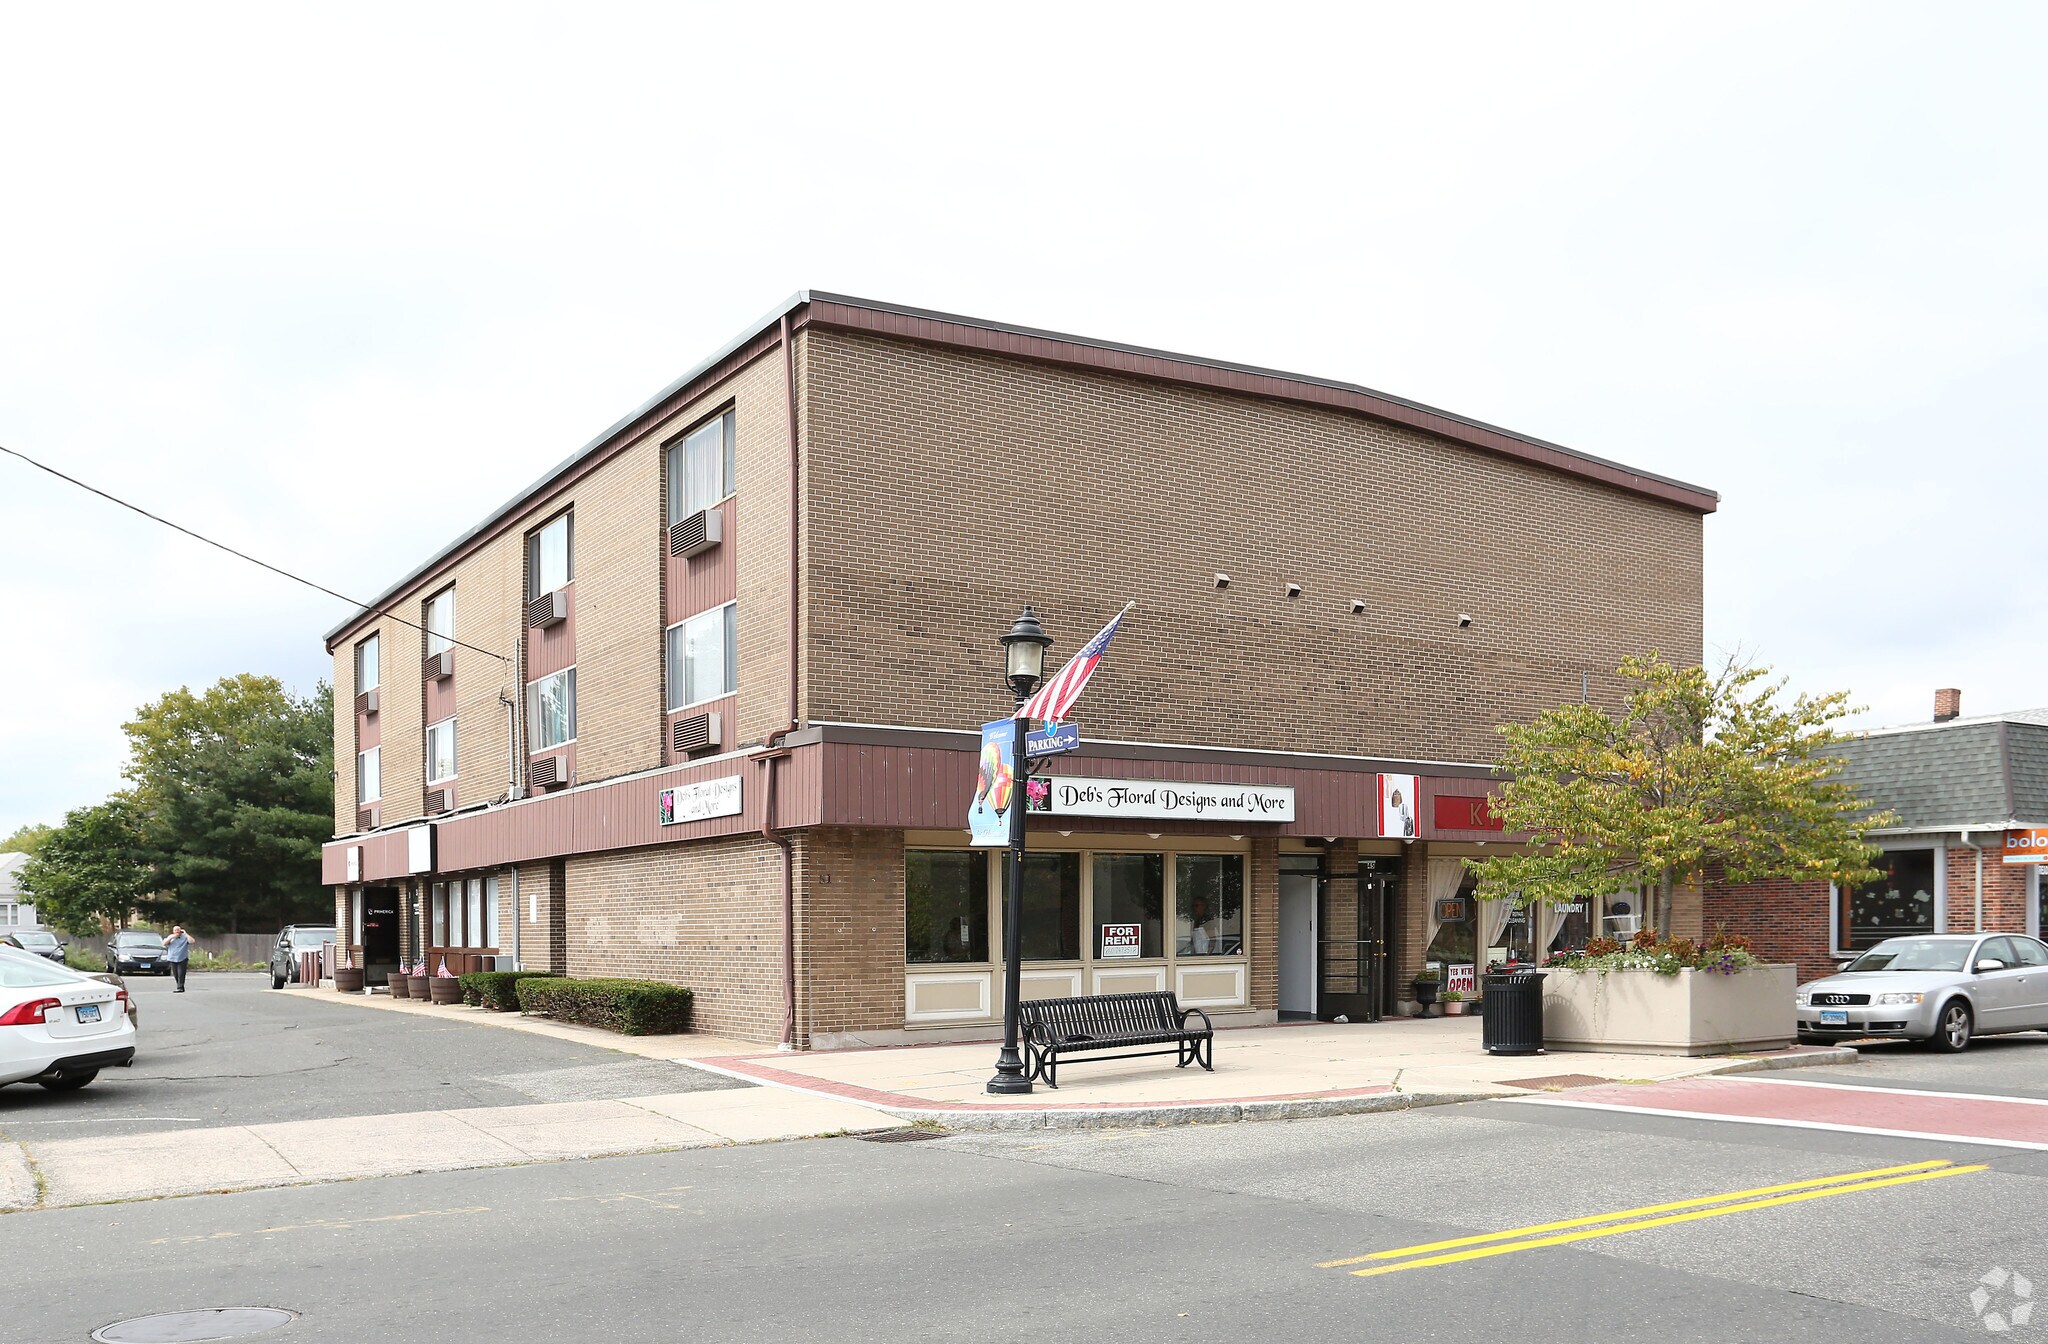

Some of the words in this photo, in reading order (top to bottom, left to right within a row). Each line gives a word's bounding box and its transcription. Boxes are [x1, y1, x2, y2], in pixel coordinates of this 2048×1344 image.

[1028, 735, 1063, 752] PARKING
[1059, 785, 1103, 806] Deb's
[1107, 787, 1156, 808] Floral
[1160, 789, 1217, 813] Designs
[1220, 793, 1244, 808] and
[1248, 793, 1285, 813] More
[1441, 902, 1461, 919] OPEN
[1554, 903, 1584, 913] LAUNDRY
[1109, 927, 1134, 936] FOR
[1105, 936, 1138, 945] RENT
[1450, 968, 1459, 976] YES
[1461, 967, 1473, 976] WE'RE
[1449, 977, 1473, 992] OPEN
